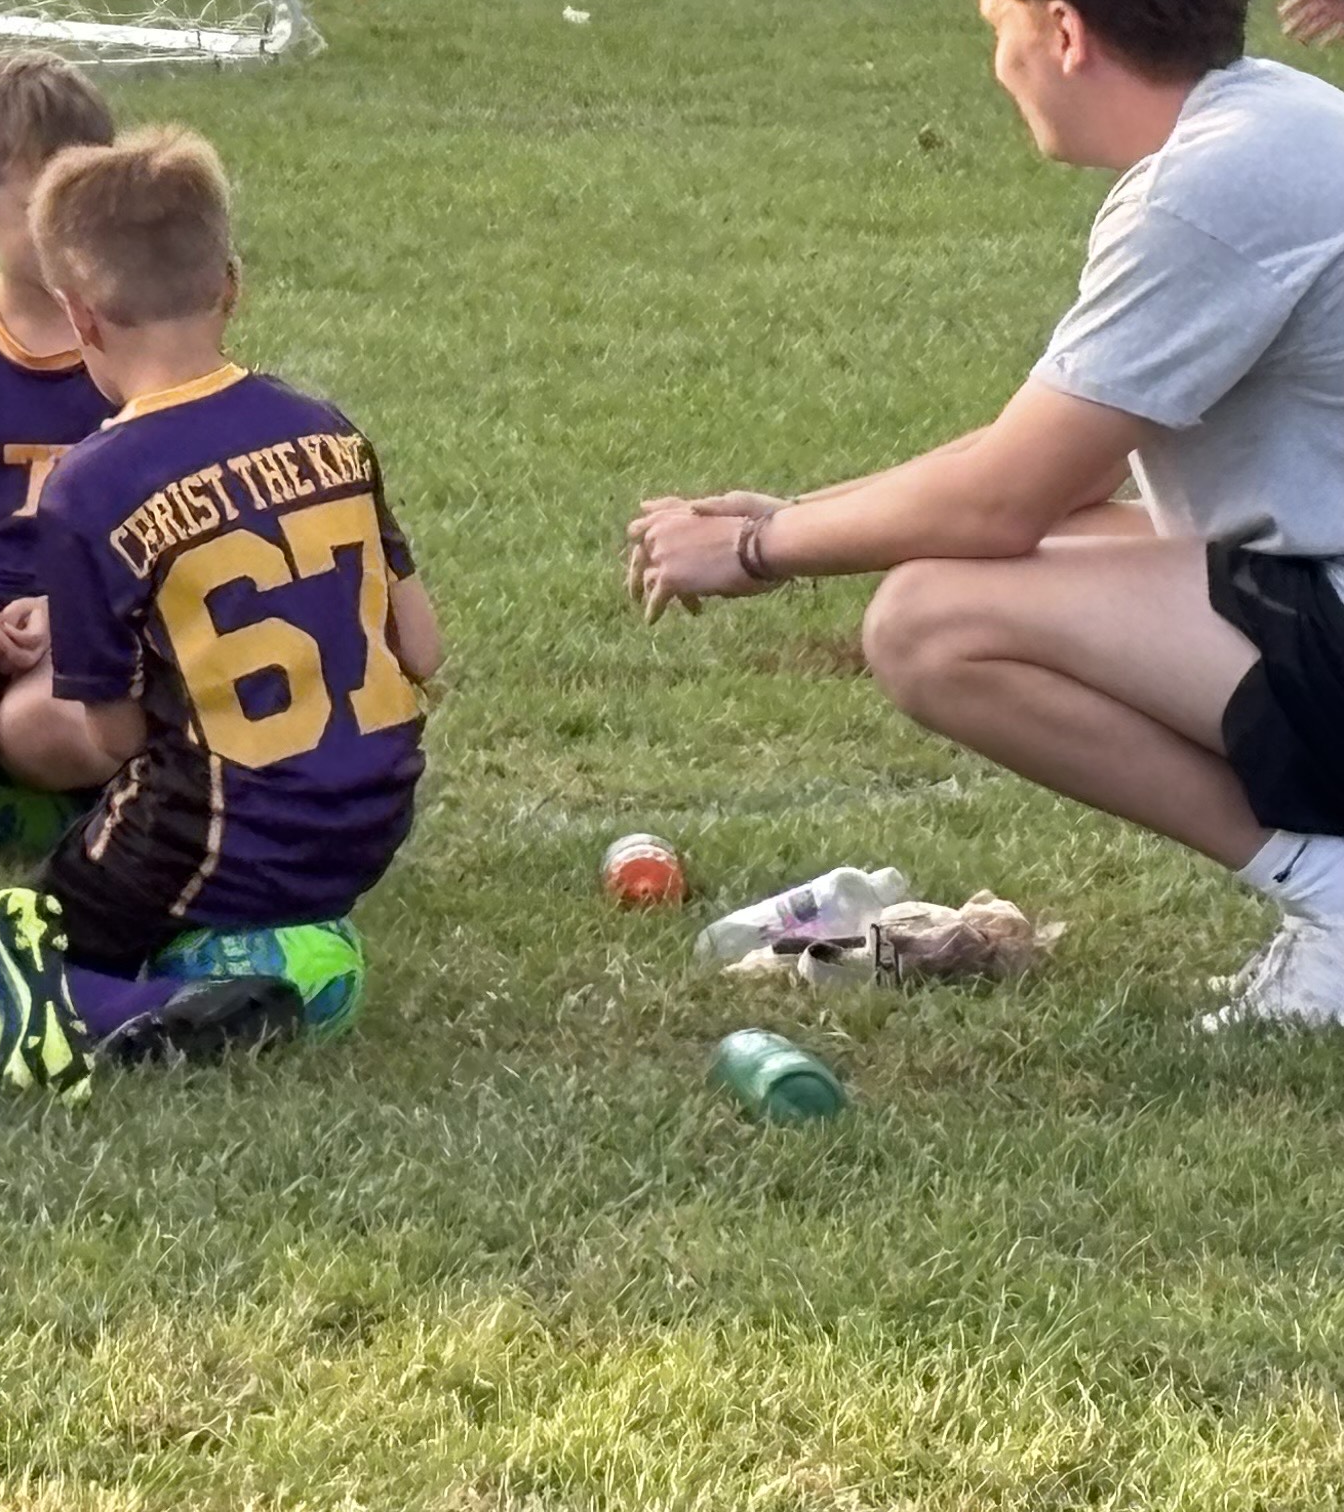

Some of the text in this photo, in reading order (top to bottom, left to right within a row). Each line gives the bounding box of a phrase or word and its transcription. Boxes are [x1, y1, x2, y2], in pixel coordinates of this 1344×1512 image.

[109, 462, 240, 579] CHRIST
[227, 441, 316, 510] THE
[153, 493, 422, 768] 67
